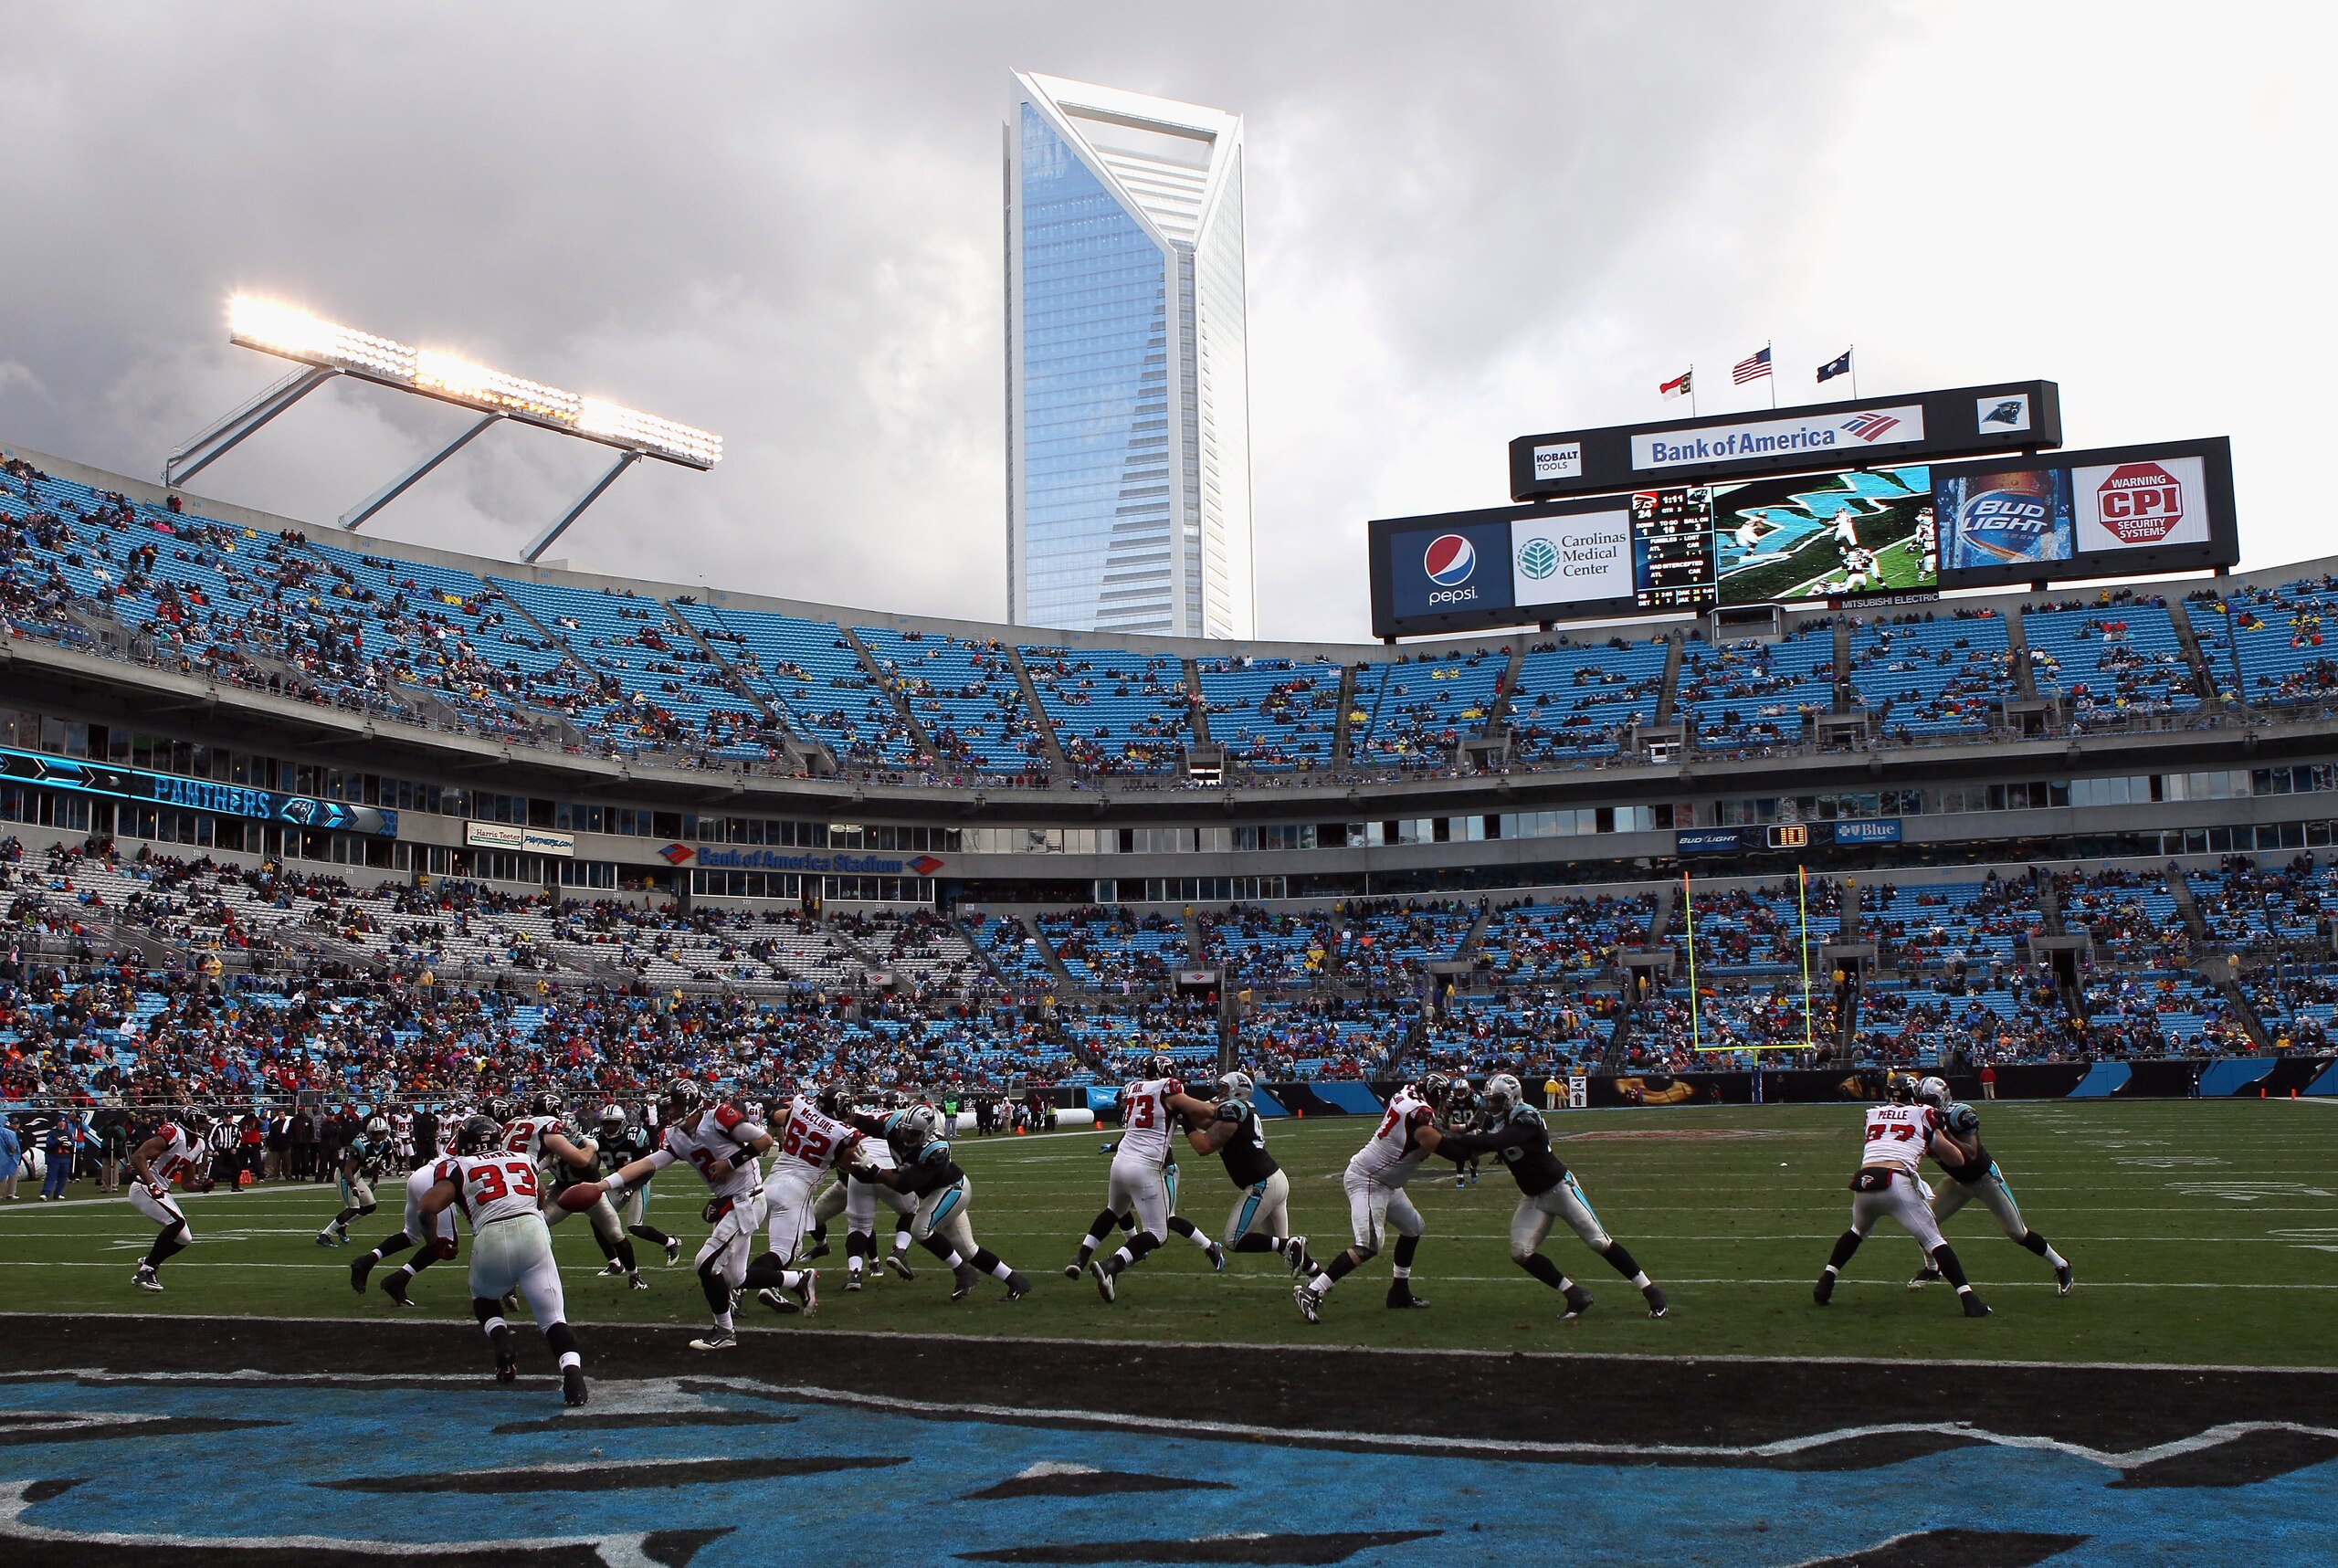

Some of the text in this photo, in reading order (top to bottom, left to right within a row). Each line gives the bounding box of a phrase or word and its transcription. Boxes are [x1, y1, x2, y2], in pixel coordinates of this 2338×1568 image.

[1652, 427, 1835, 462] Bank of America
[1537, 451, 1578, 463] KOBALT
[1537, 462, 1568, 471] TOOLS
[2112, 475, 2166, 489] WARNING
[1663, 495, 1683, 504] 1:11
[2103, 488, 2178, 518] CPI
[1638, 510, 1652, 519] 24
[1699, 504, 1705, 512] 7
[1975, 500, 2045, 518] BUD
[1960, 517, 2048, 533] LIGHT
[2118, 518, 2165, 530] SECURITY
[1562, 532, 1626, 548] Carolinas
[2120, 527, 2165, 539] SYSTEMS
[1563, 546, 1617, 563] Medical
[1564, 564, 1609, 577] Center
[1663, 561, 1703, 569] INTERCEPTED
[1429, 586, 1476, 605] pepsi
[1842, 593, 1939, 609] MITSUBISHI ELECTRIC
[154, 776, 270, 819] PANTHERS
[477, 829, 521, 840] Harris Teeter
[1780, 826, 1805, 846] 10
[1862, 823, 1895, 837] Blue
[1680, 835, 1738, 845] BUD LIGHT
[700, 847, 903, 873] Bank of America Stadium
[1124, 1095, 1154, 1129] 73
[1878, 1110, 1909, 1121] PEELLE
[398, 1121, 411, 1132] 83
[441, 1121, 451, 1132] 14
[800, 1108, 836, 1134] McCLURE
[502, 1122, 535, 1153] 72
[627, 1126, 638, 1141] 23
[784, 1118, 831, 1167] 62
[690, 1147, 717, 1184] 2
[468, 1163, 537, 1206] 33
